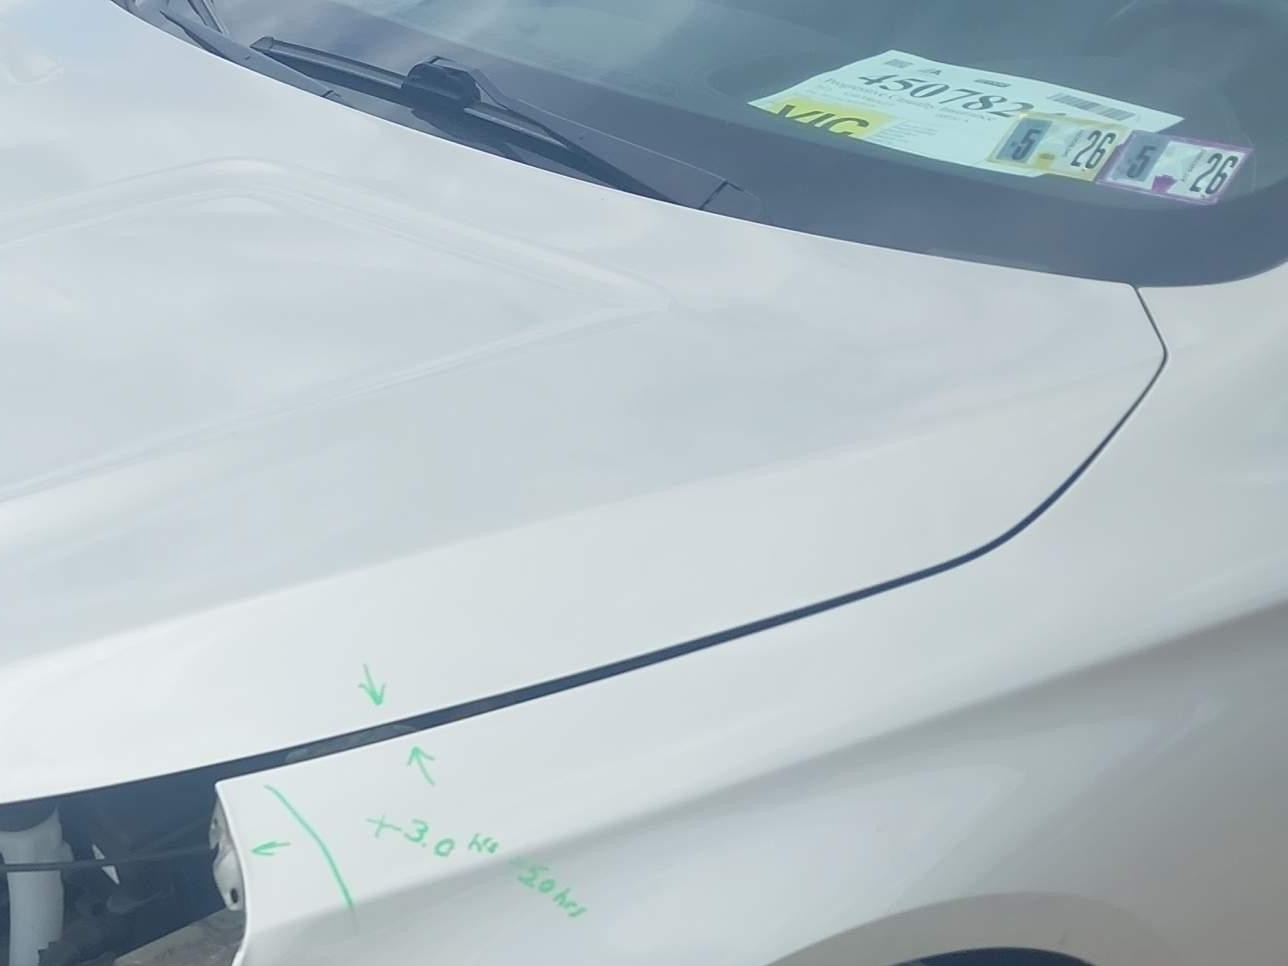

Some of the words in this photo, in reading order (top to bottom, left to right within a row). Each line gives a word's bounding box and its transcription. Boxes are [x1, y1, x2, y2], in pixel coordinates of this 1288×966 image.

[858, 74, 1066, 118] 450782
[1011, 128, 1042, 160] 5
[1070, 129, 1117, 170] 26
[1125, 146, 1158, 179] 5
[1189, 152, 1240, 195] 26
